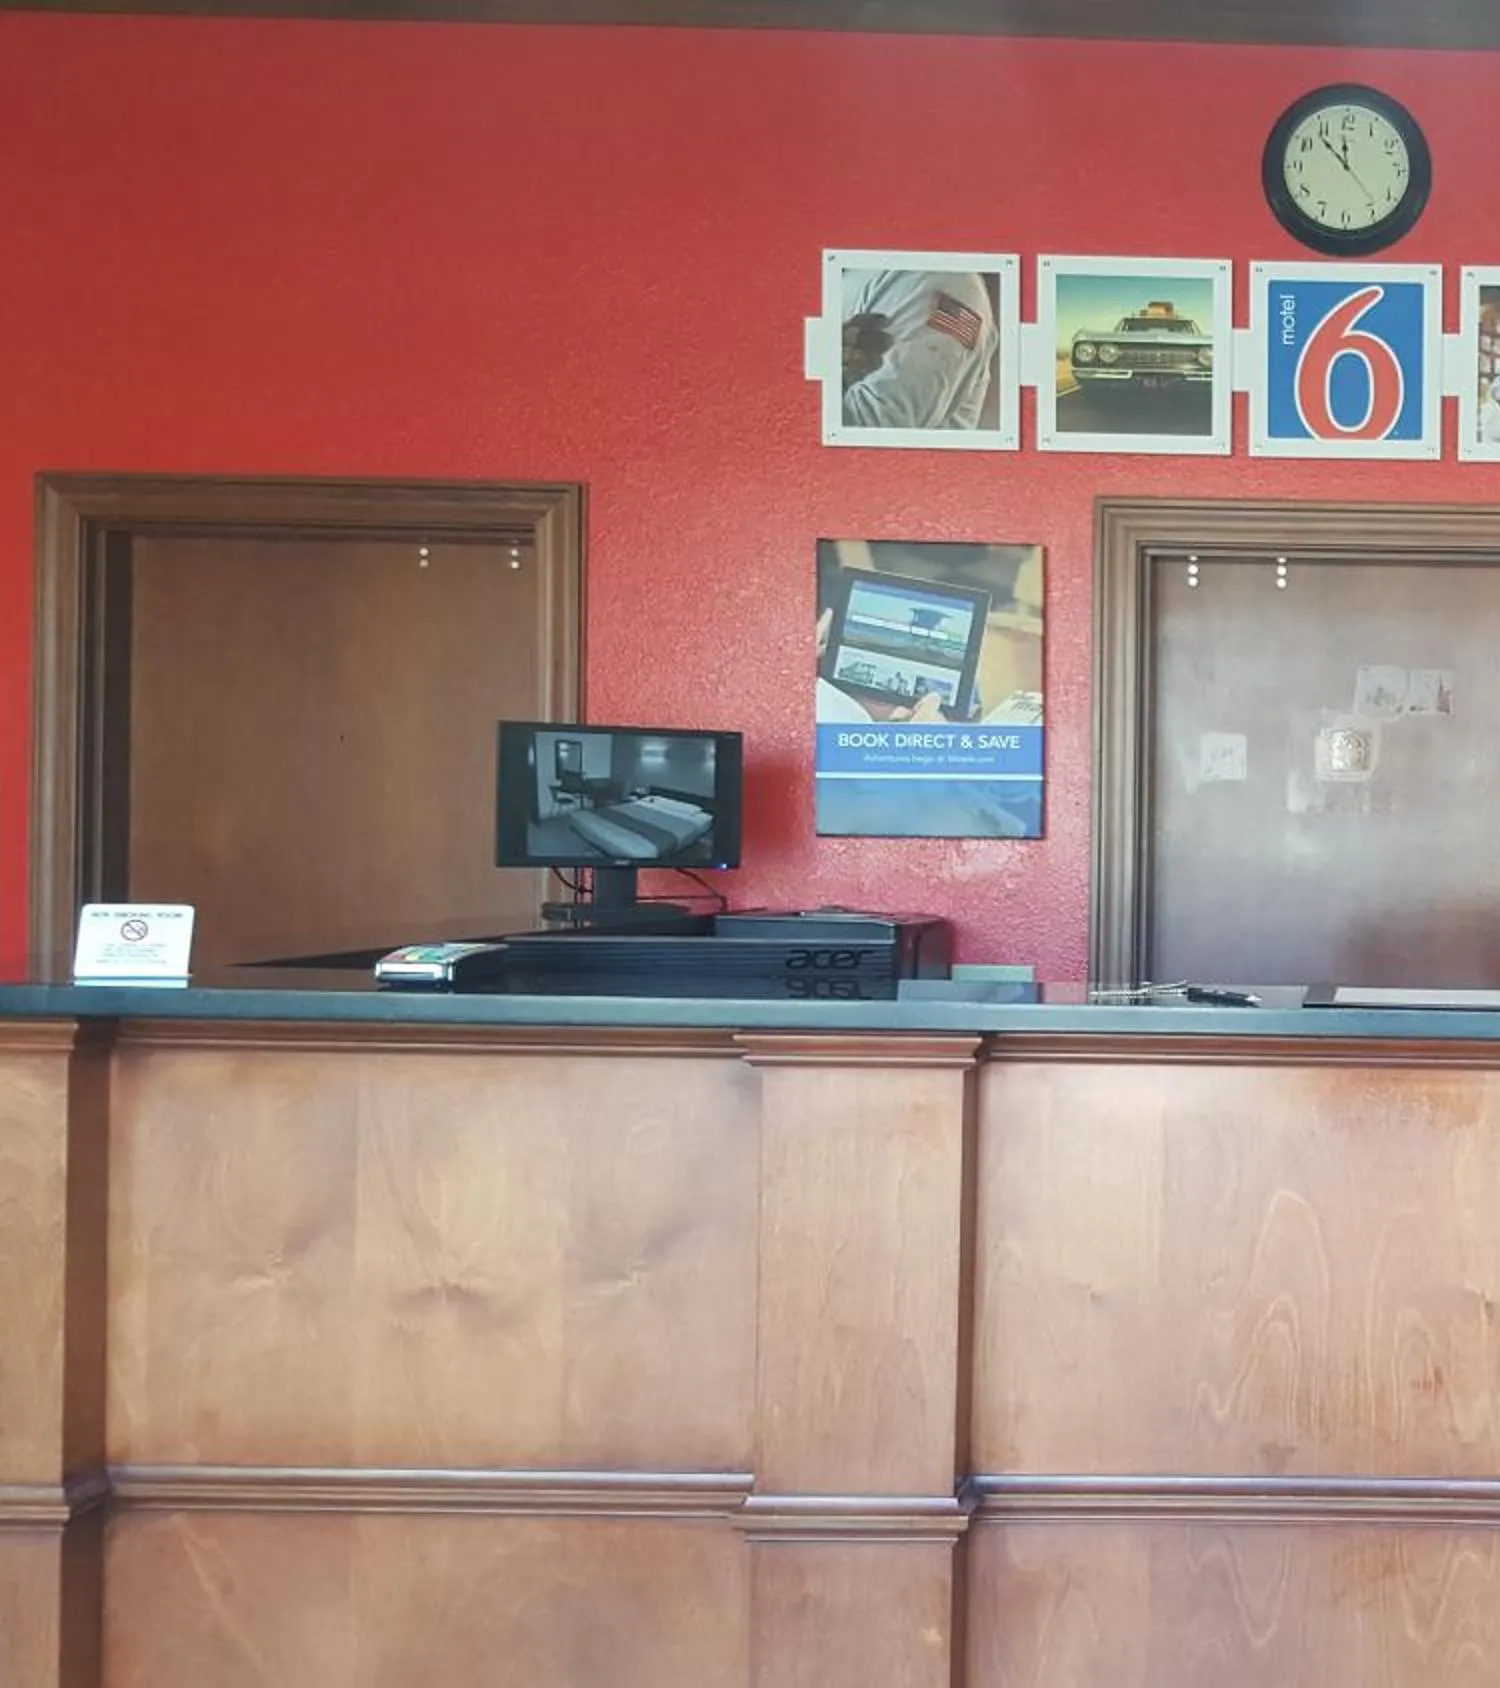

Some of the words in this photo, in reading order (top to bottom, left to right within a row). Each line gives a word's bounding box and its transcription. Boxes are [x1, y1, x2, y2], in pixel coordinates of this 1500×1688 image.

[1319, 121, 1329, 137] 11
[1279, 294, 1296, 345] motel
[1293, 285, 1405, 441] 6
[837, 733, 890, 749] BOOK
[895, 733, 955, 750] DIRECT
[960, 734, 973, 750] &
[977, 735, 1022, 750] SAVE
[785, 949, 874, 970] acer
